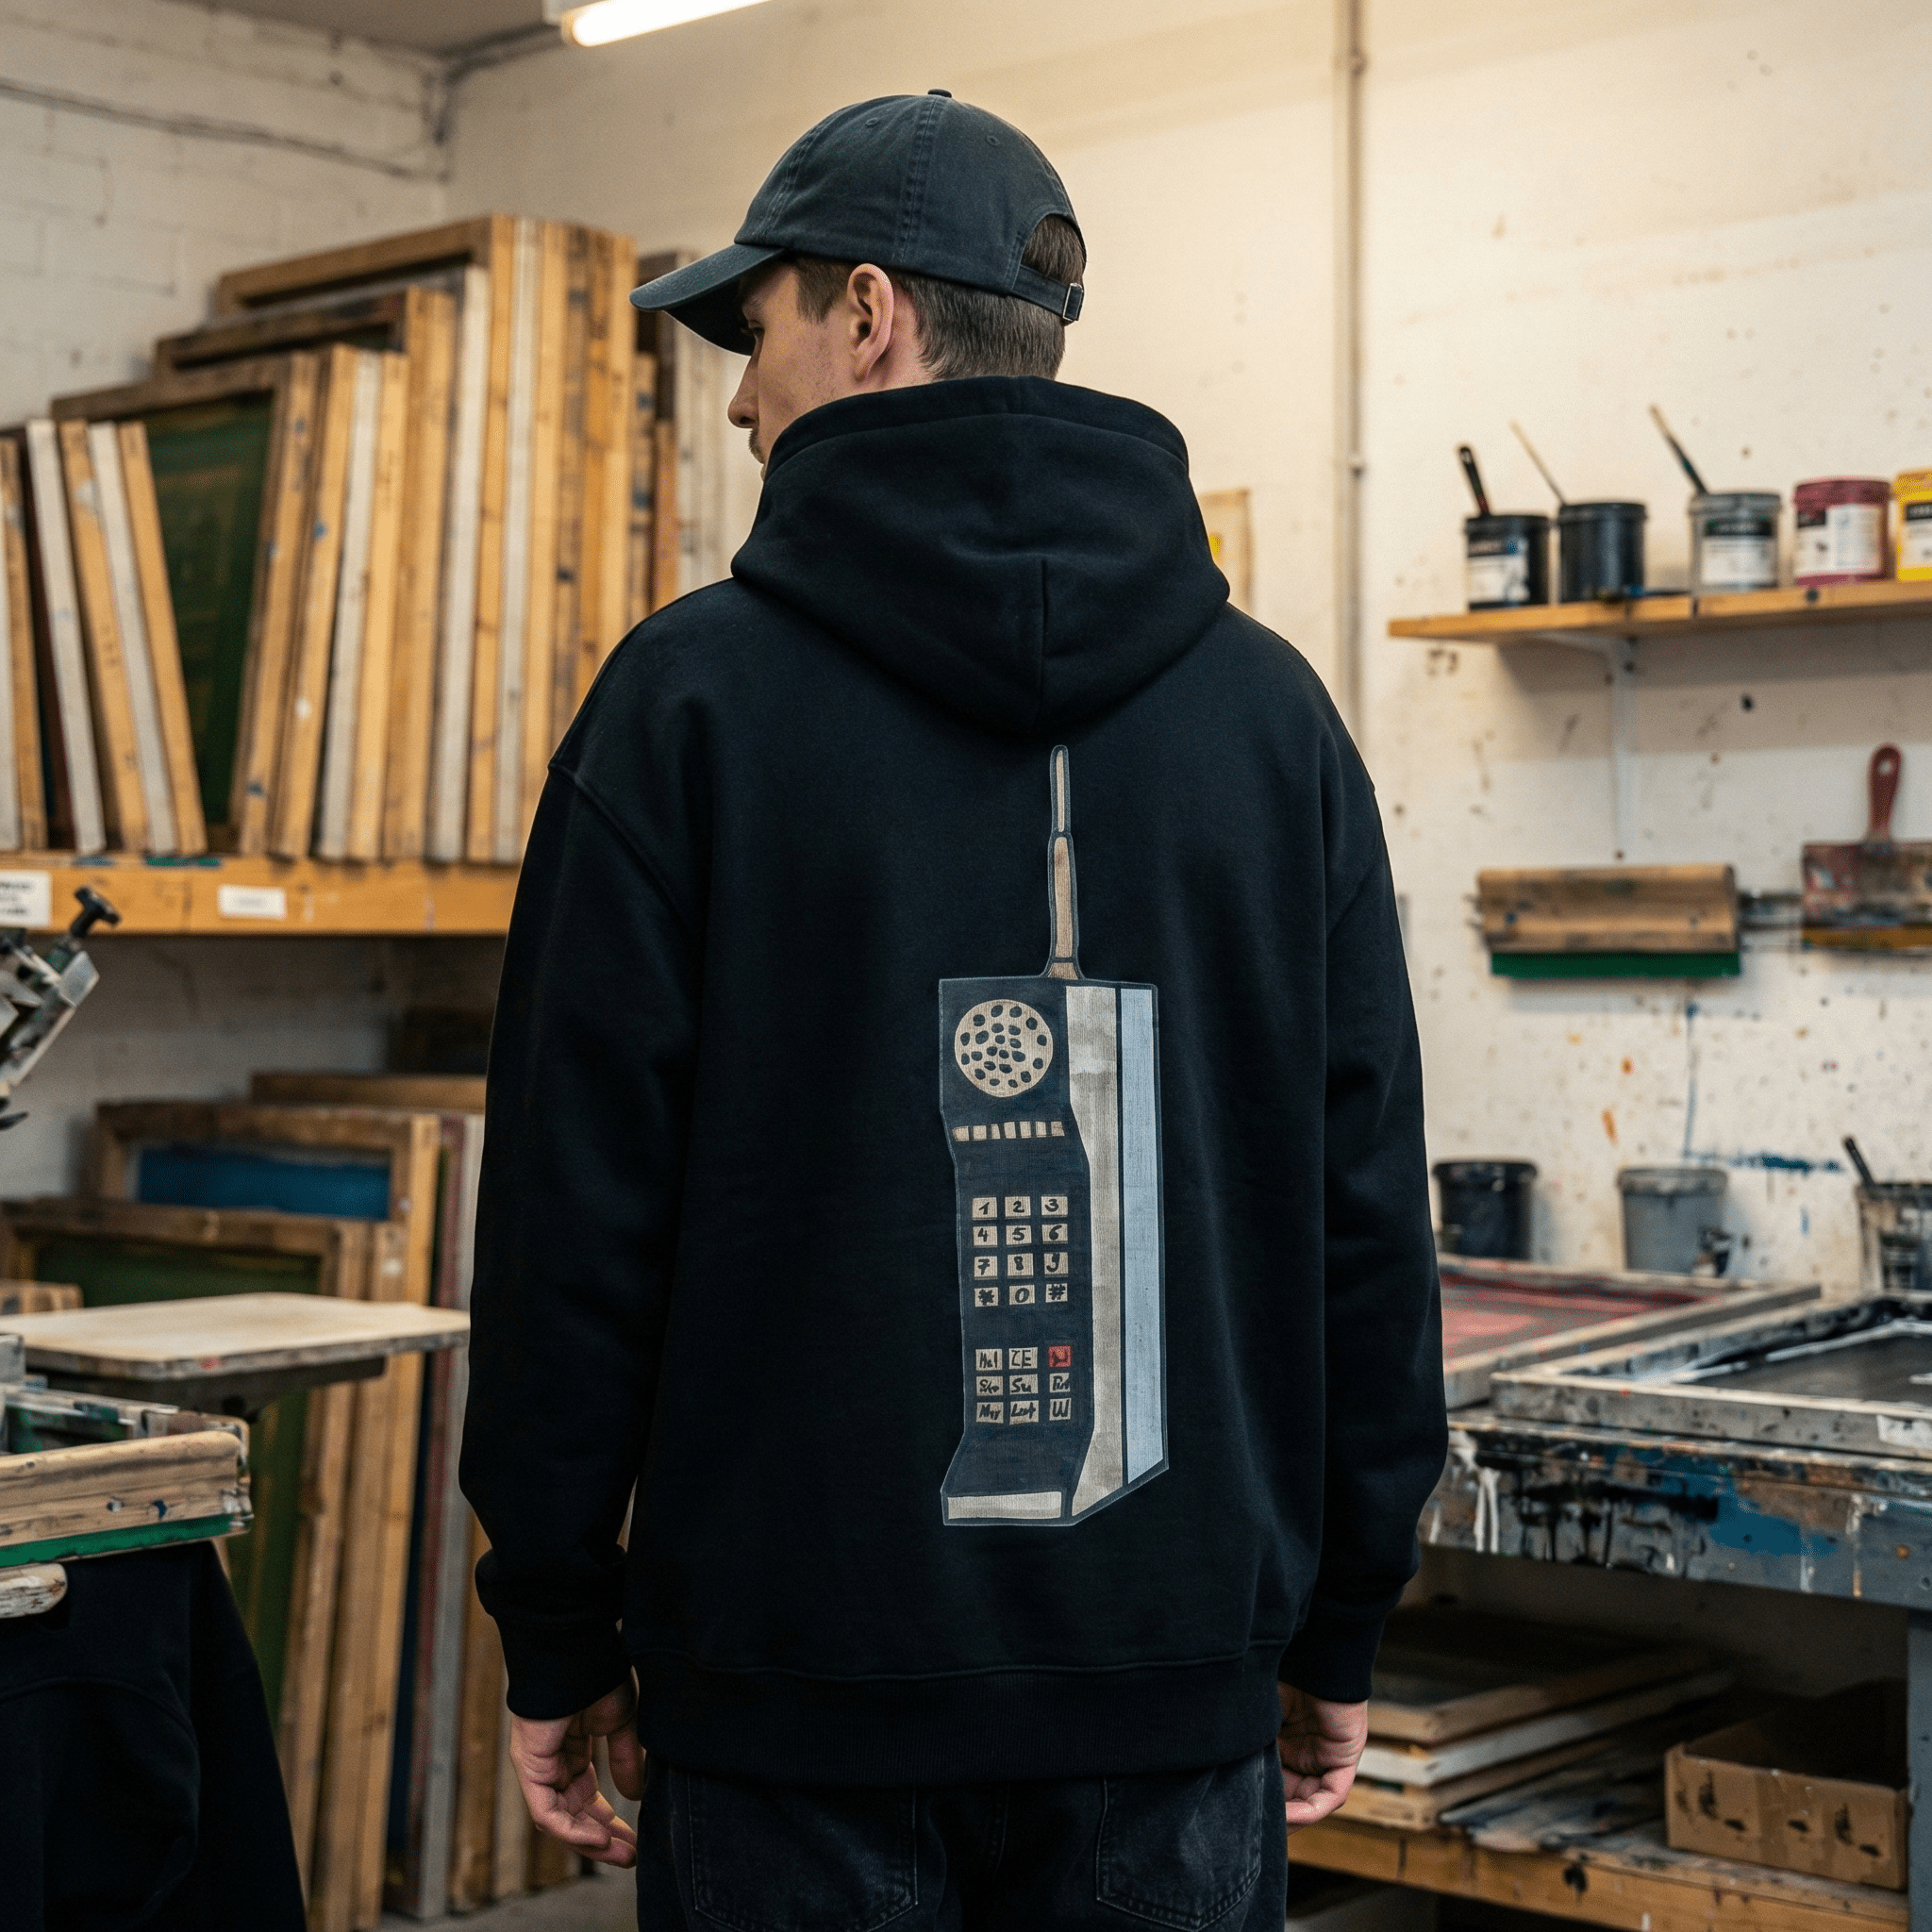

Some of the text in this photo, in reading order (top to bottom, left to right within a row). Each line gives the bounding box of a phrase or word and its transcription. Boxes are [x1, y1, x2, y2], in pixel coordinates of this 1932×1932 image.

[978, 1198, 1059, 1215] 1 2 3
[977, 1224, 1063, 1242] 4 5 6
[976, 1257, 991, 1276] 7
[1013, 1255, 1024, 1272] 8
